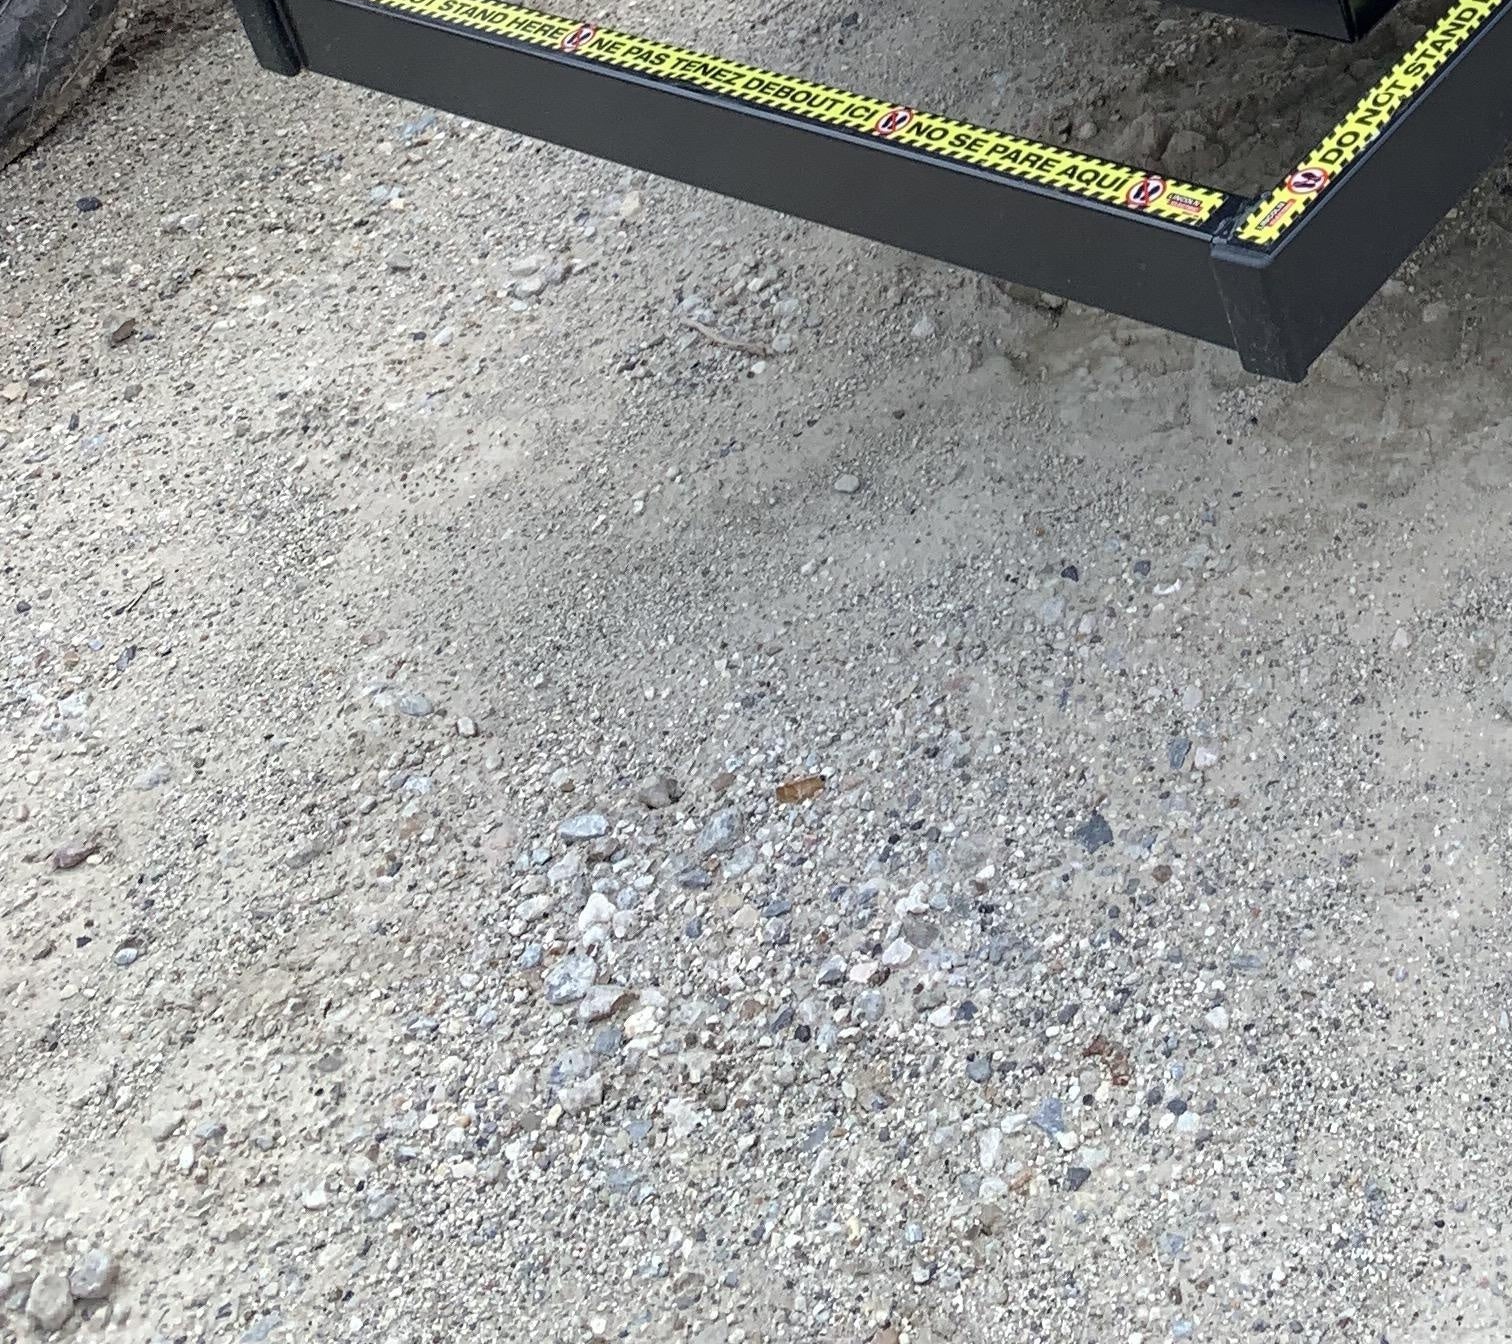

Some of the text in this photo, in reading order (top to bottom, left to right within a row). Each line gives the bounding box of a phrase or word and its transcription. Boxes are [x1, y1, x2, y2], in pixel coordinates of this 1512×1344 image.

[507, 16, 571, 41] HERE
[589, 37, 879, 122] NE PAS TENEZ DEBOUT ICI
[1318, 131, 1360, 165] DO
[1355, 79, 1406, 126] NOT
[1403, 6, 1479, 78] STAND
[907, 121, 949, 141] NO
[949, 132, 987, 151] SE
[985, 143, 1062, 173] PARE
